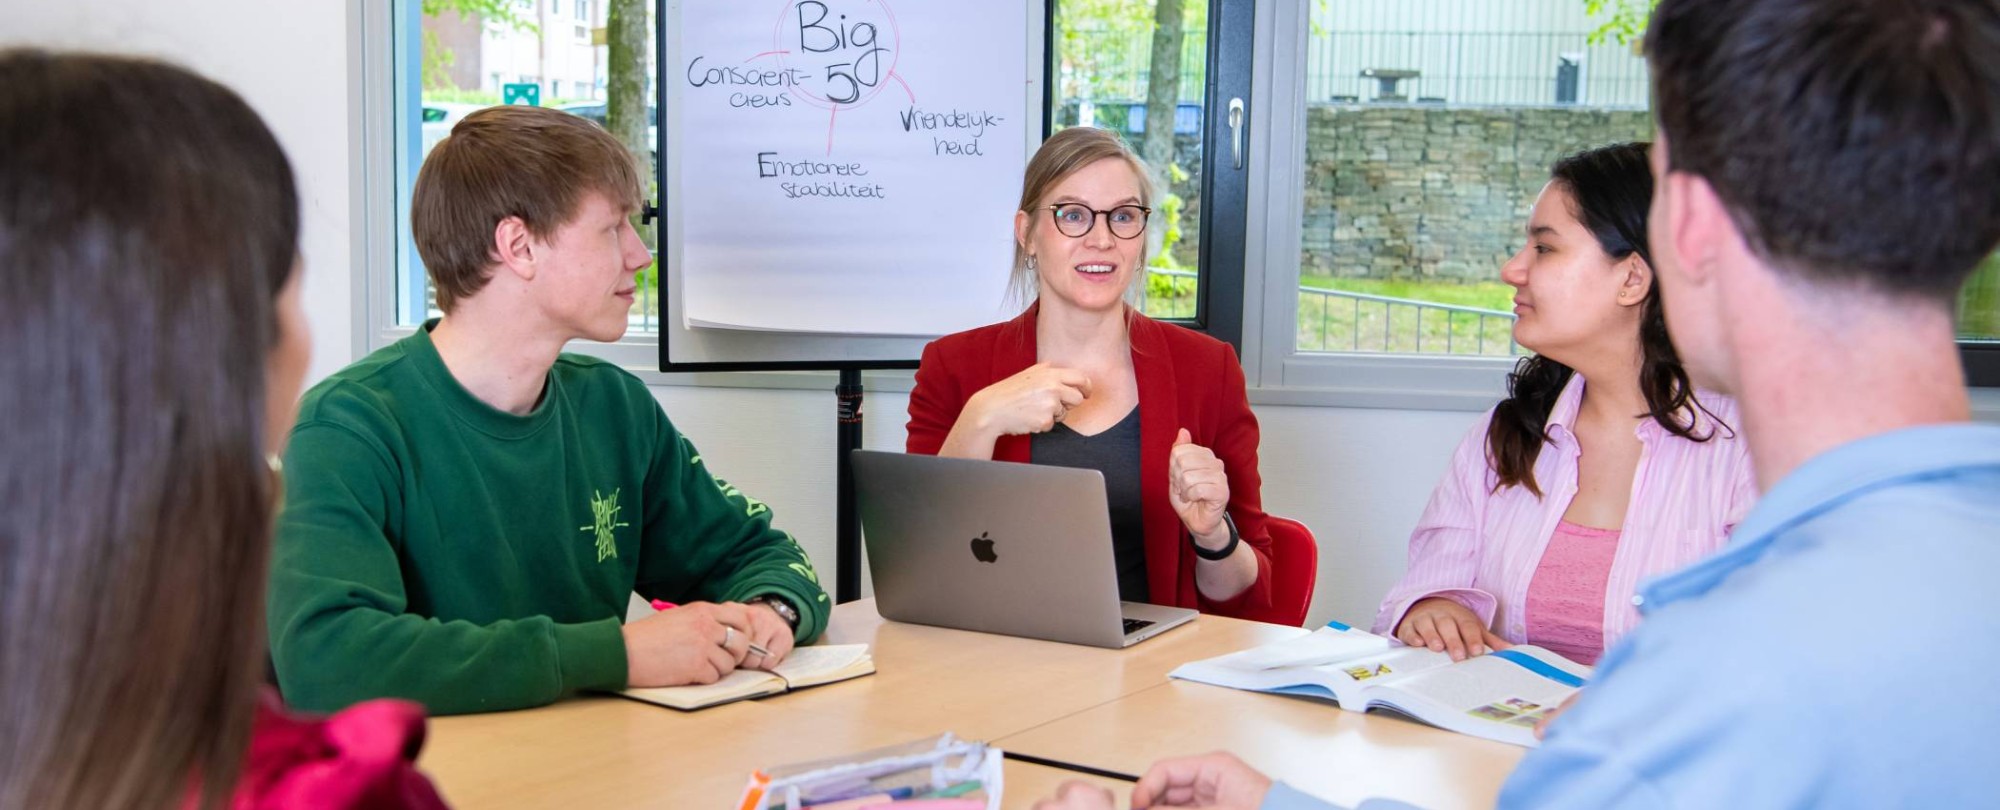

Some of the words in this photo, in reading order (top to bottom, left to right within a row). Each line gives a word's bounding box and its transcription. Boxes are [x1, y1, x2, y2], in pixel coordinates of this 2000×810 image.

[795, 0, 890, 87] Big
[825, 63, 860, 104] 5
[933, 136, 984, 156] heid
[757, 151, 869, 179] Emotionele
